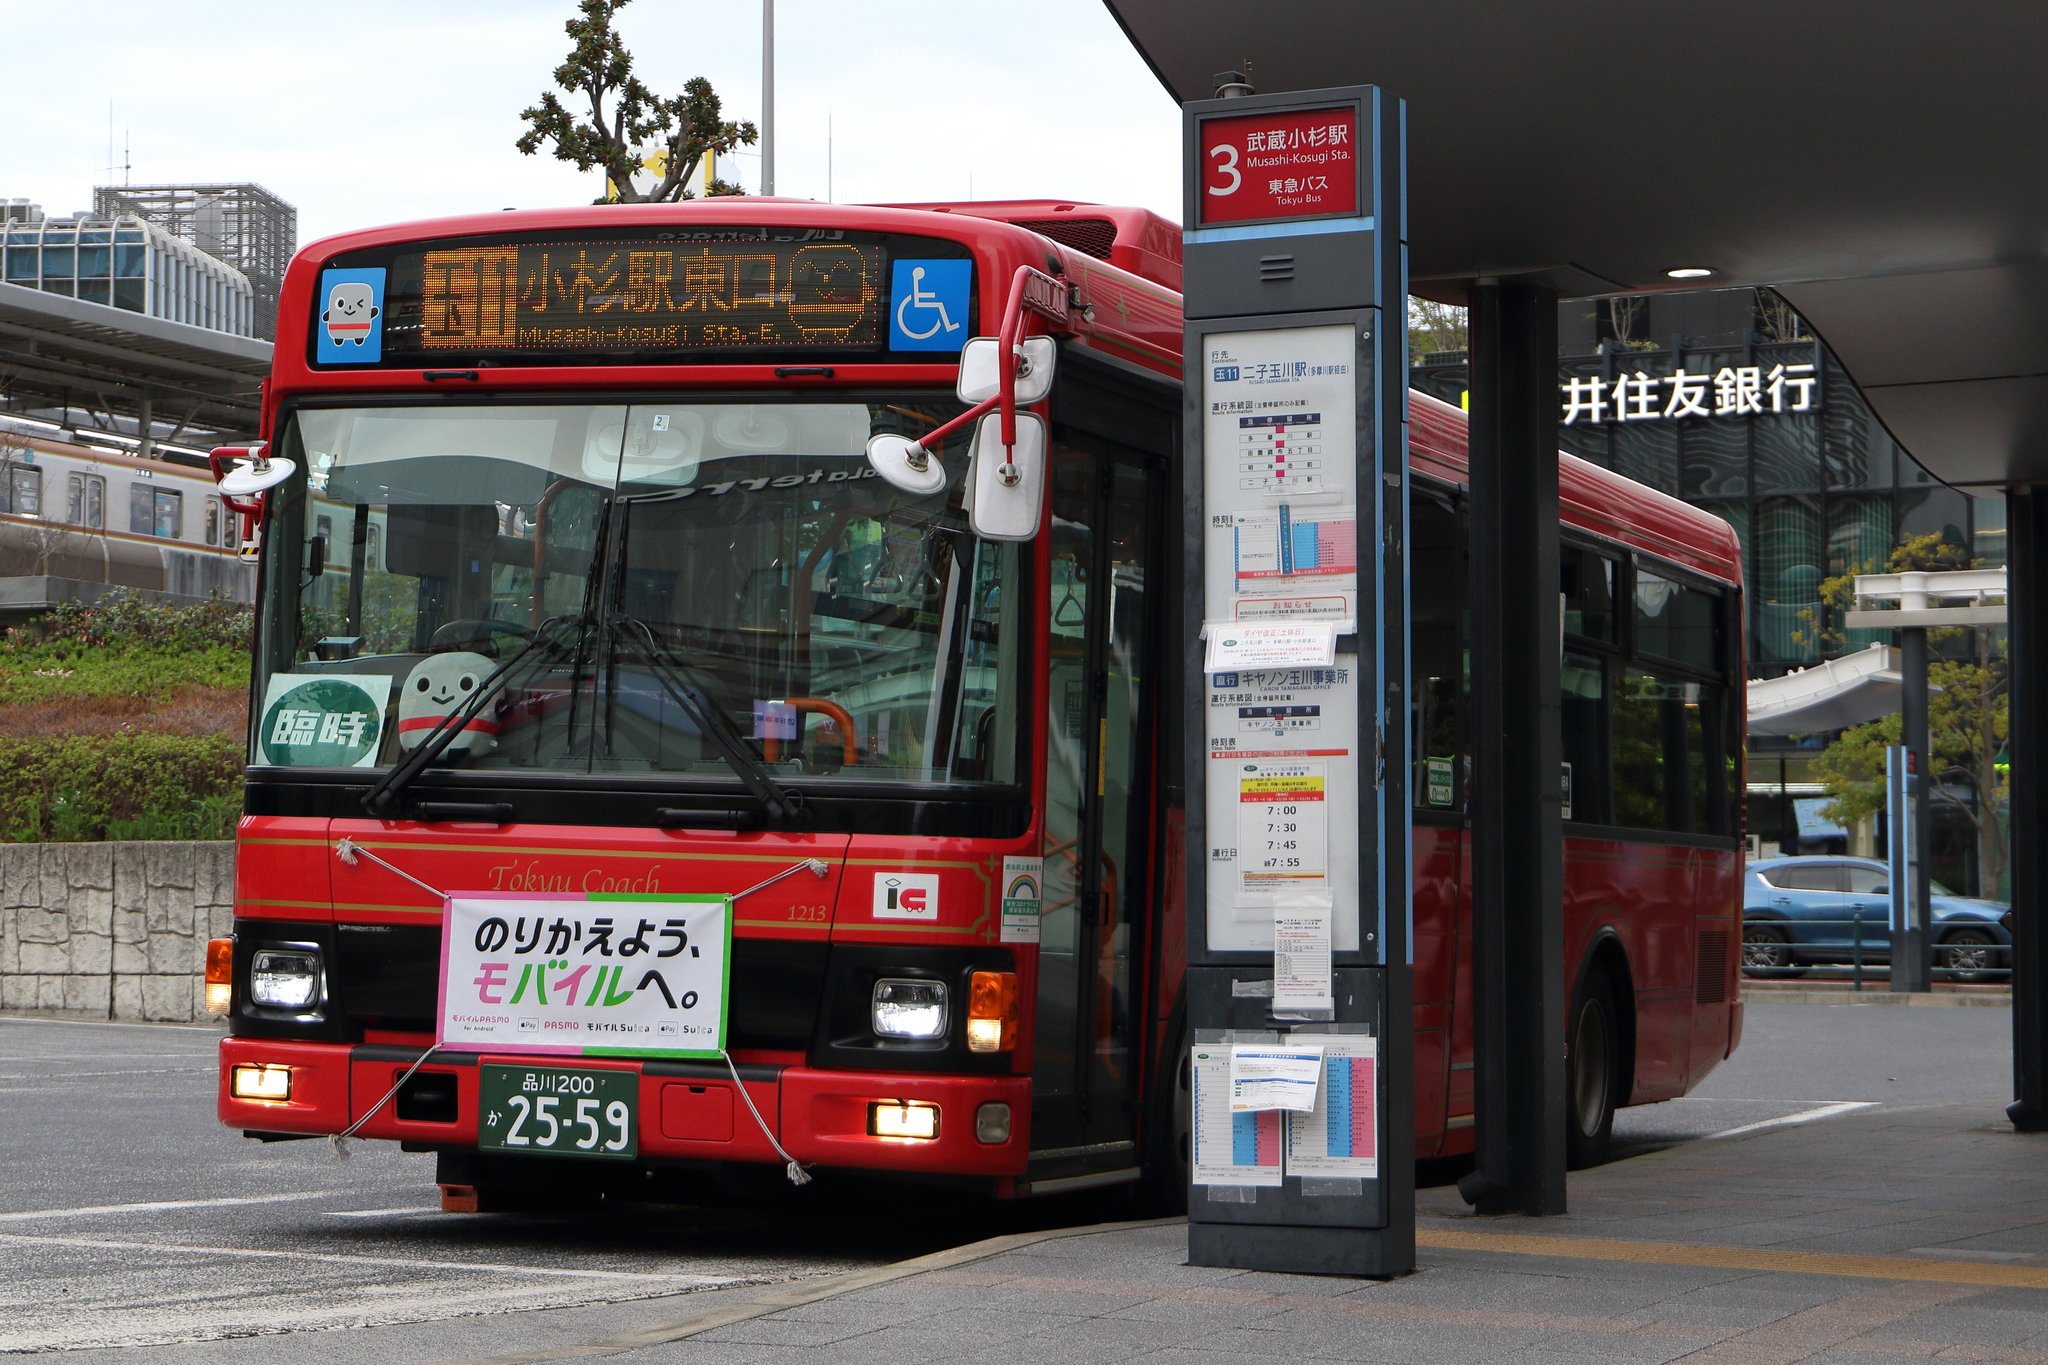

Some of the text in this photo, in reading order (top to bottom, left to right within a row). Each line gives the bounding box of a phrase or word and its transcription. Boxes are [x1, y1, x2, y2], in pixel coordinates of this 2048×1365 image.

[1247, 124, 1348, 152] 武蔵小杉駅
[1247, 149, 1351, 168] Musashi-Kosugi Sta.
[1208, 144, 1242, 196] 3
[1268, 176, 1328, 195] 東急バス
[1277, 194, 1322, 206] Tokyu Bus
[431, 247, 776, 336] 玉11 小杉駅東口
[519, 325, 688, 345] Musashi-Kosugi
[1212, 351, 1228, 359] 行先
[1216, 368, 1238, 380] 玉11
[1243, 362, 1307, 379] 二子玉川駅
[1562, 363, 1816, 425] 井住友銀行
[1212, 401, 1253, 411] 運行系統図
[1273, 601, 1312, 609] お知らせ
[1217, 669, 1348, 687] 直行 キヤノン玉川事業所
[1211, 693, 1252, 703] 運行系統図
[270, 709, 368, 747] 臨時
[1211, 738, 1236, 746] 時刻表
[1267, 806, 1297, 815] 7:00
[1267, 823, 1297, 832] 7:30
[1212, 848, 1237, 856] 運行日
[1267, 840, 1297, 849] 7:45
[488, 859, 661, 894] Tokyu Coach
[788, 905, 826, 921] 1213
[474, 917, 700, 958] のりかえよう、
[473, 959, 699, 1009] モバイルへ。
[452, 1014, 510, 1024] モバイルPASMO
[526, 1021, 536, 1030] Pay
[544, 1021, 579, 1030] PASMO
[665, 1025, 676, 1033] Pay
[683, 1025, 713, 1034] Suica
[522, 1073, 594, 1094] 品川200
[487, 1095, 629, 1151] か 25-59
